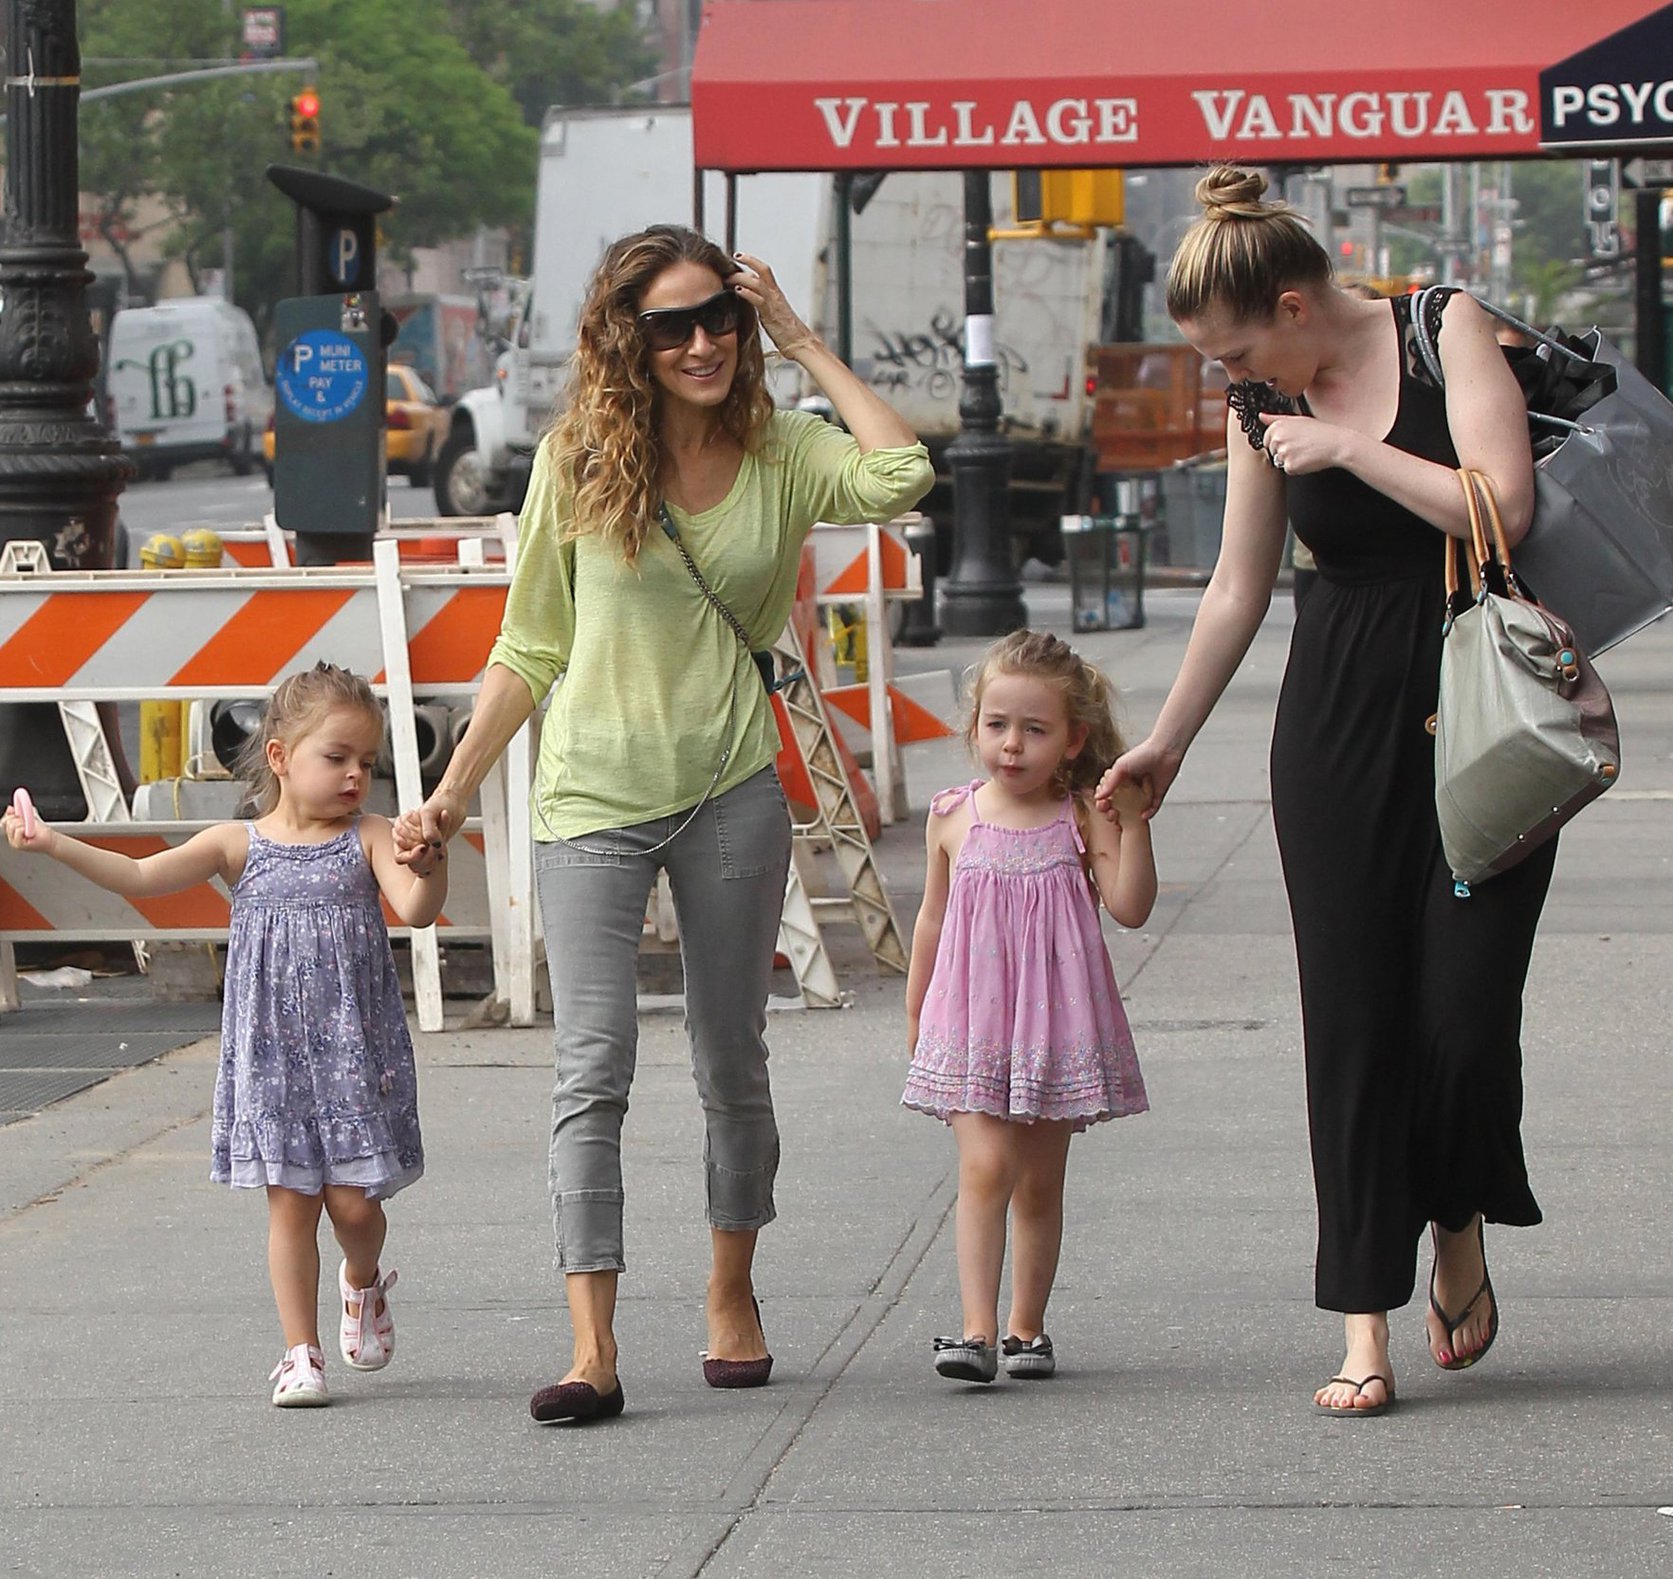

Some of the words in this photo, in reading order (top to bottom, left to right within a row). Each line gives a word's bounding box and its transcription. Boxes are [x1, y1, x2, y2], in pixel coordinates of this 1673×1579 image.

[814, 97, 1138, 147] VILLAGE
[1191, 88, 1534, 140] VANGUAR
[339, 229, 358, 280] P
[320, 344, 351, 356] MUNI
[294, 344, 314, 373] P
[320, 359, 362, 372] METER
[308, 376, 333, 389] PAY
[315, 390, 326, 402] &
